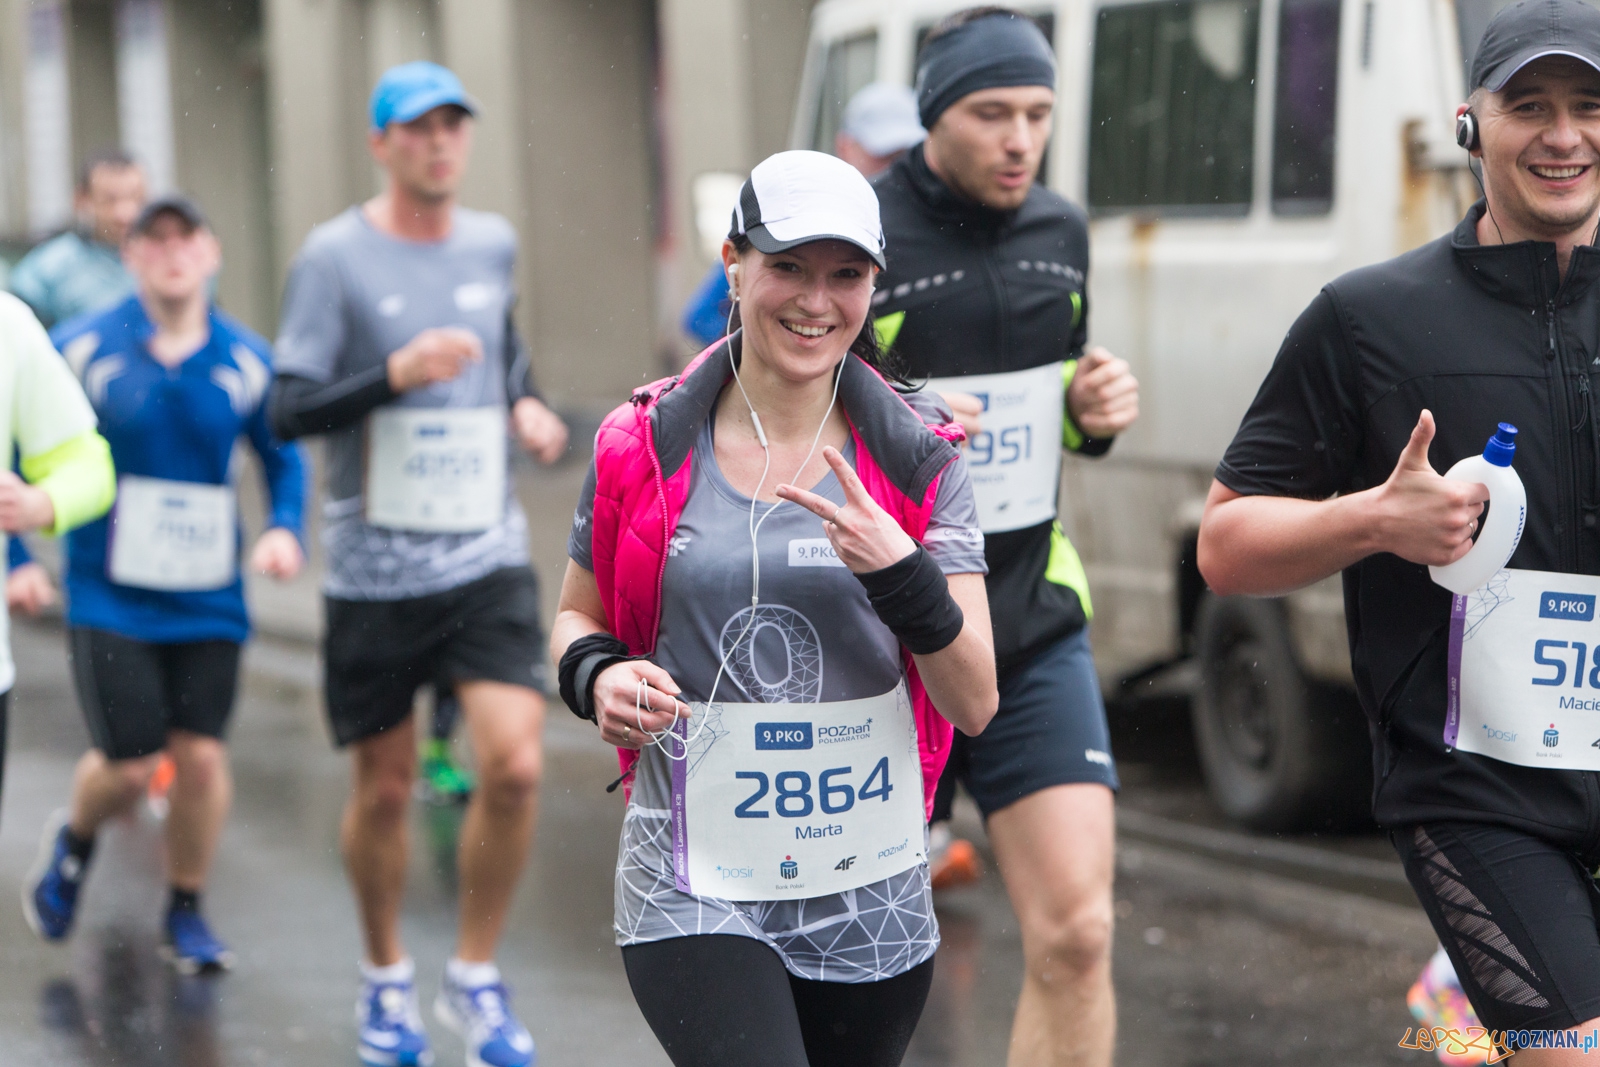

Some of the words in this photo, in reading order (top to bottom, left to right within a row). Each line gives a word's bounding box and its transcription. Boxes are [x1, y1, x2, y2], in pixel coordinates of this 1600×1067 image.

[970, 424, 1032, 466] 951
[1559, 601, 1587, 614] PKO
[1559, 696, 1600, 711] Macie
[775, 729, 804, 743] PKO
[734, 756, 893, 818] 2864
[795, 824, 843, 839] Marta
